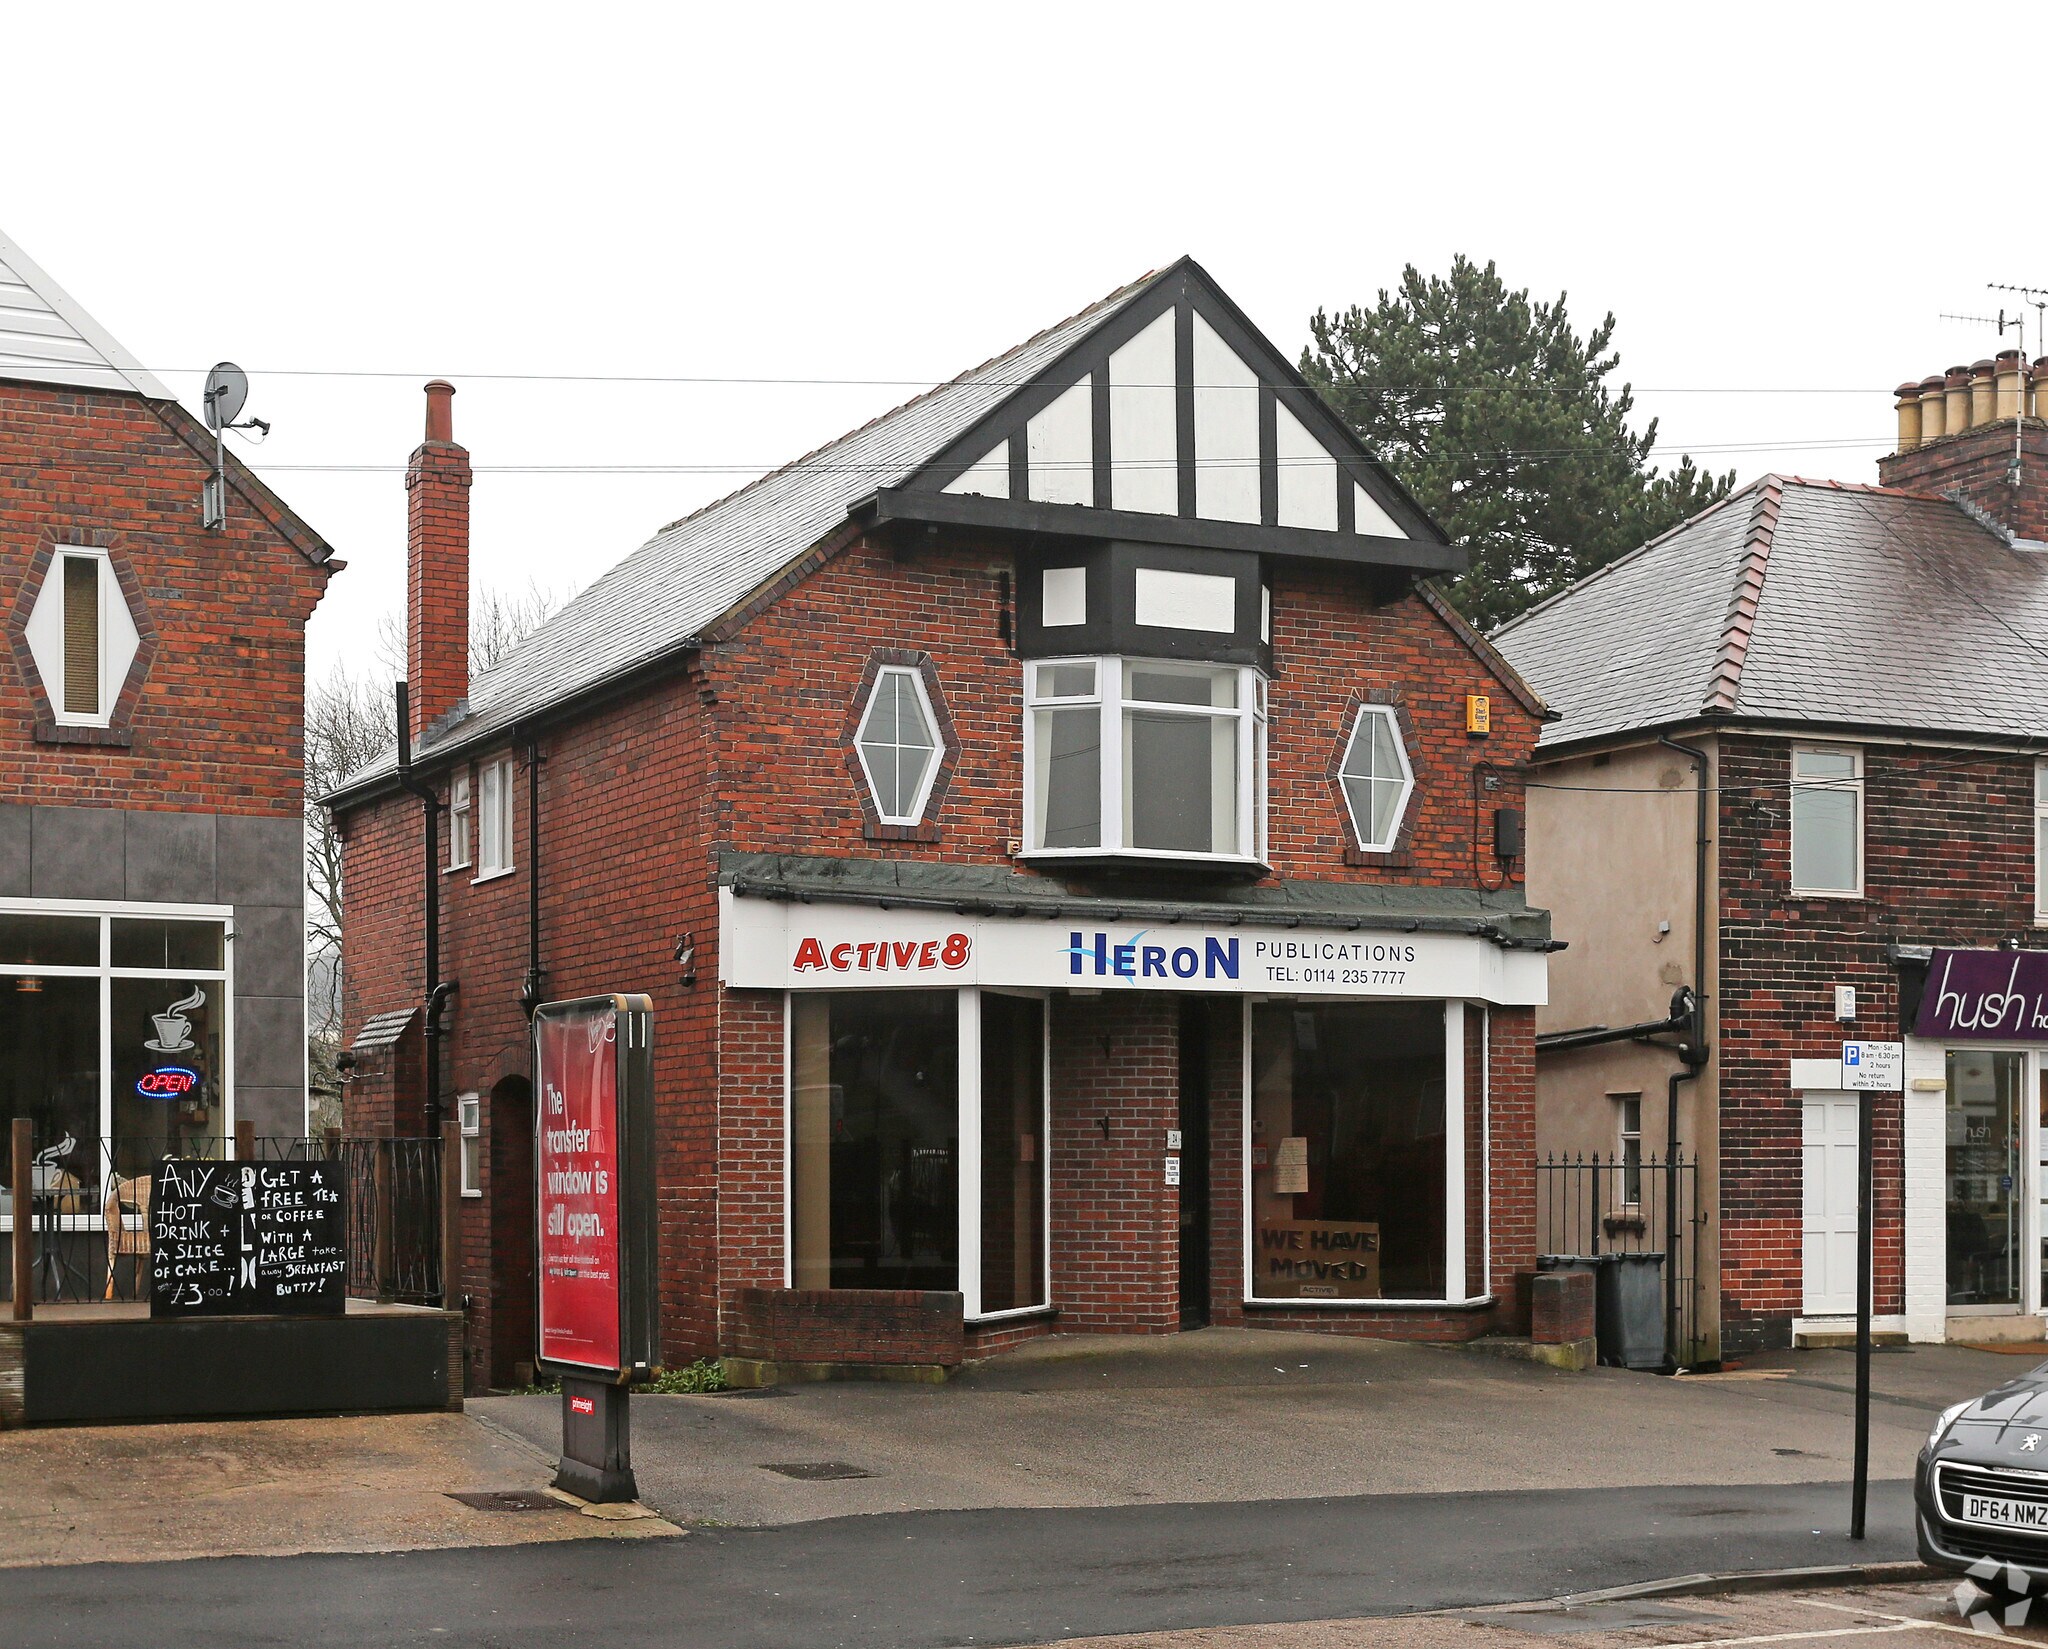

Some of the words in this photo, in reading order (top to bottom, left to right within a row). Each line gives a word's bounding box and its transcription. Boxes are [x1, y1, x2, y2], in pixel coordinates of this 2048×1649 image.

[792, 933, 973, 973] ACTIVE8
[1069, 930, 1240, 980] HERON
[1256, 941, 1415, 962] PUBLICATIONS
[1266, 966, 1299, 982] TEL:
[1303, 967, 1335, 984] 0114
[1342, 968, 1368, 984] 235
[1371, 970, 1406, 985] 7777
[1934, 953, 2026, 1032] hush
[141, 1074, 193, 1092] OPEN
[546, 1083, 563, 1115] The
[546, 1119, 591, 1154] transfer
[159, 1164, 215, 1198] ANY
[260, 1167, 300, 1188] GET
[310, 1170, 323, 1185] A
[547, 1162, 593, 1195] window
[595, 1160, 609, 1195] is
[313, 1188, 339, 1203] TEA
[157, 1202, 202, 1223] HOT
[276, 1210, 325, 1222] COFFEE
[155, 1221, 210, 1240] DRINK
[220, 1224, 230, 1237] +
[547, 1203, 565, 1237] still
[567, 1212, 605, 1244] open.
[302, 1229, 312, 1241] A
[1261, 1228, 1304, 1251] WE
[1310, 1230, 1378, 1252] HAVE
[155, 1248, 168, 1263] A
[175, 1244, 225, 1259] SLICE
[260, 1246, 305, 1265] LARGE
[154, 1267, 170, 1279] OF
[261, 1269, 282, 1278] away
[285, 1261, 345, 1278] BREAKFAST
[1269, 1257, 1368, 1281] MOVED
[276, 1277, 326, 1296] BUTTY!
[1970, 1499, 2010, 1521] DF64
[2015, 1504, 2048, 1526] NMZ
